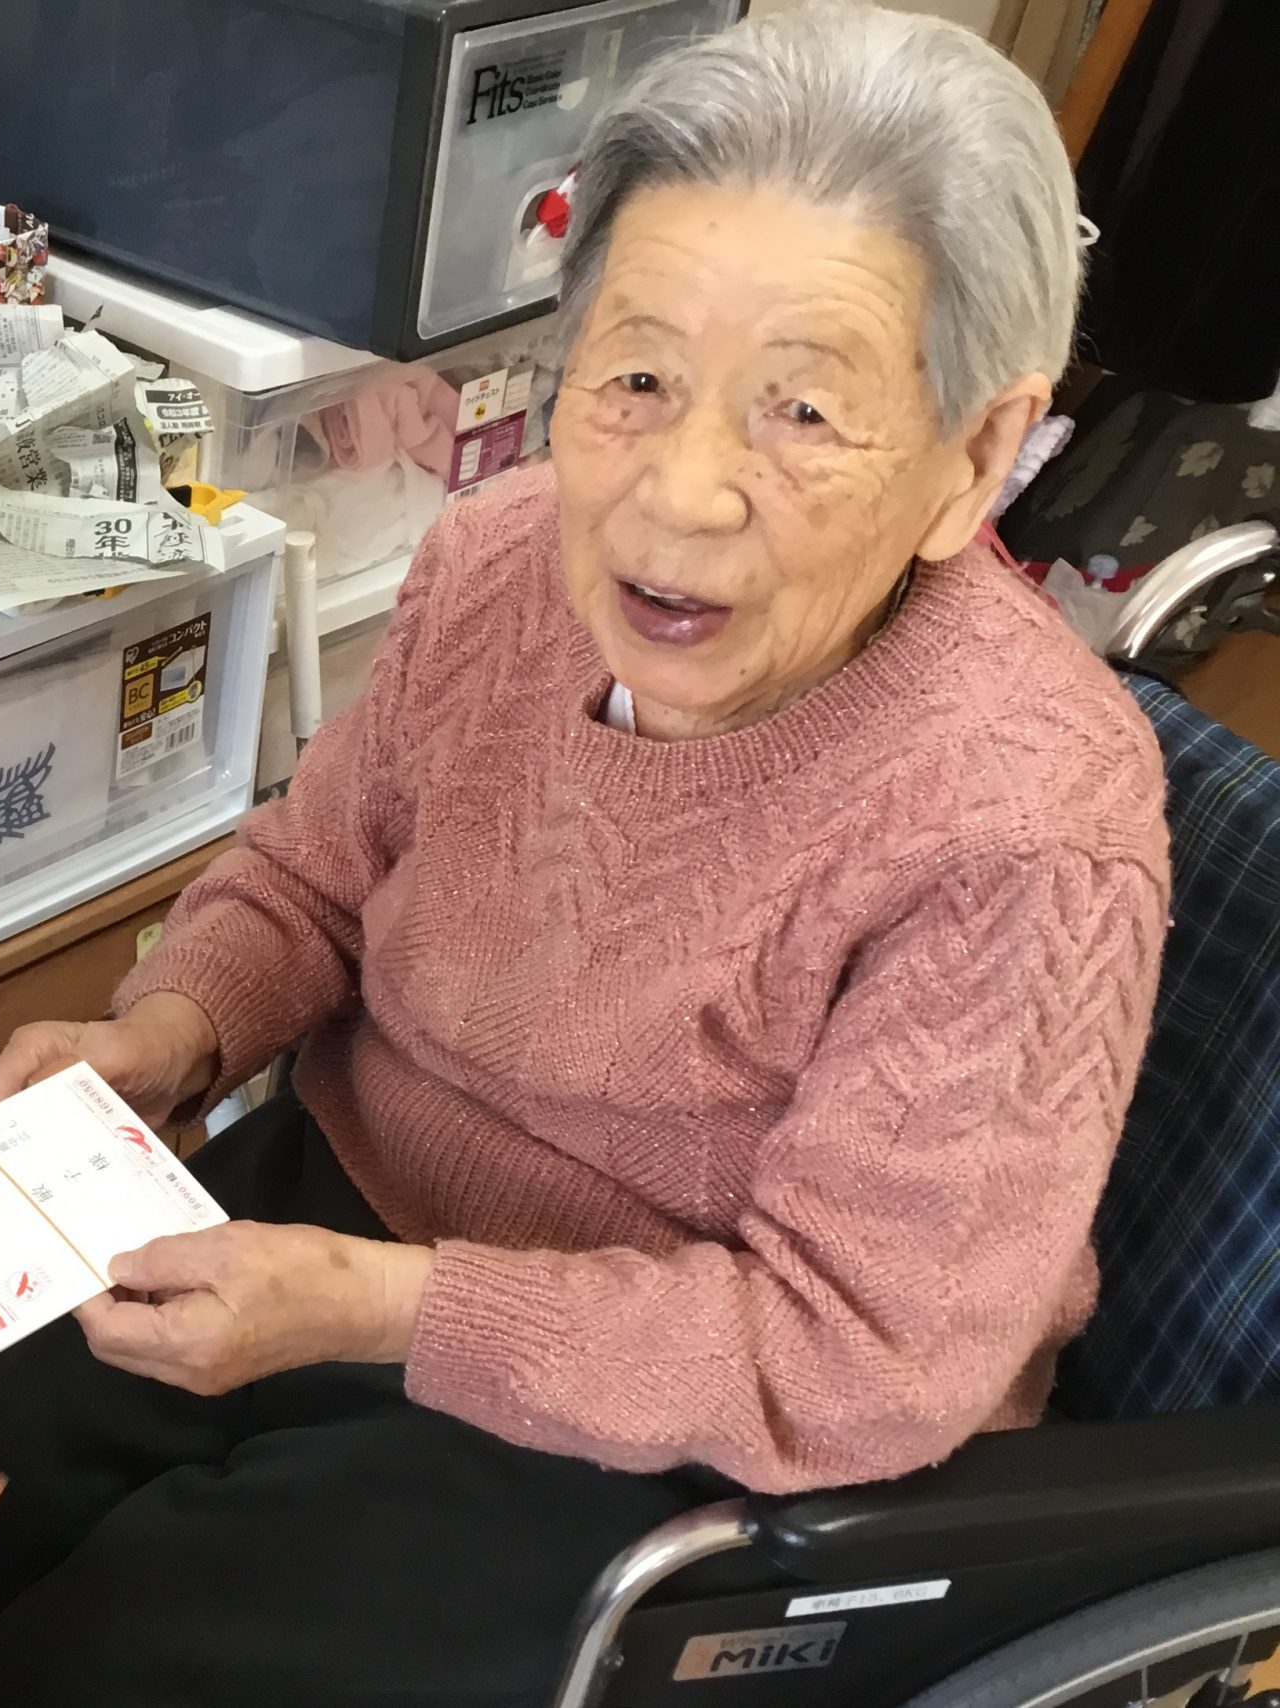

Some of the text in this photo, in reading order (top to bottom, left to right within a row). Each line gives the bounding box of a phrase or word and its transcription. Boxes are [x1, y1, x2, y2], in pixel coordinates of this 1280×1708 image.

[467, 65, 526, 125] Fits
[170, 620, 207, 644] コンパクト
[128, 682, 150, 705] BC
